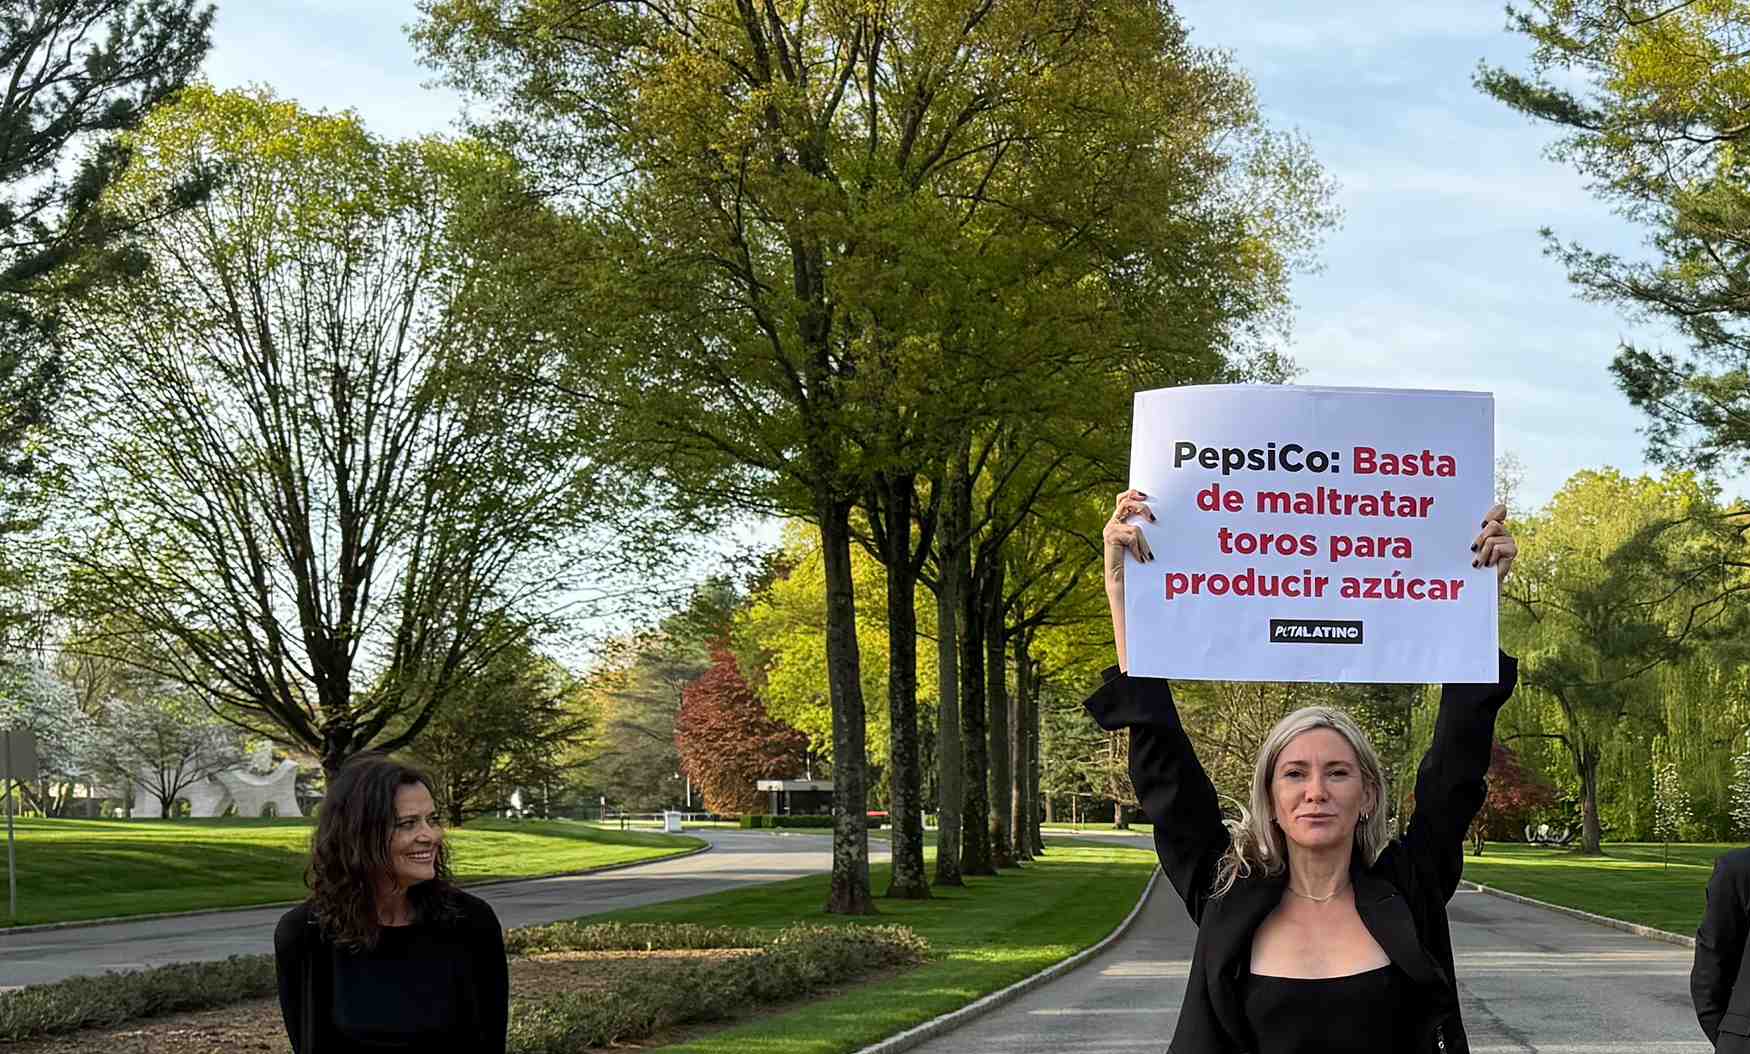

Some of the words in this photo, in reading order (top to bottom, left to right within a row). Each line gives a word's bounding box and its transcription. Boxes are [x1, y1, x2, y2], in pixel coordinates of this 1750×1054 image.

[1174, 441, 1340, 476] PepsiCo:
[1353, 446, 1456, 478] Basta
[1196, 482, 1244, 513] de
[1256, 486, 1434, 518] maltratar
[1217, 527, 1318, 557] toros
[1329, 535, 1412, 563] para
[1165, 567, 1329, 601] producir
[1339, 569, 1465, 601] azúcar
